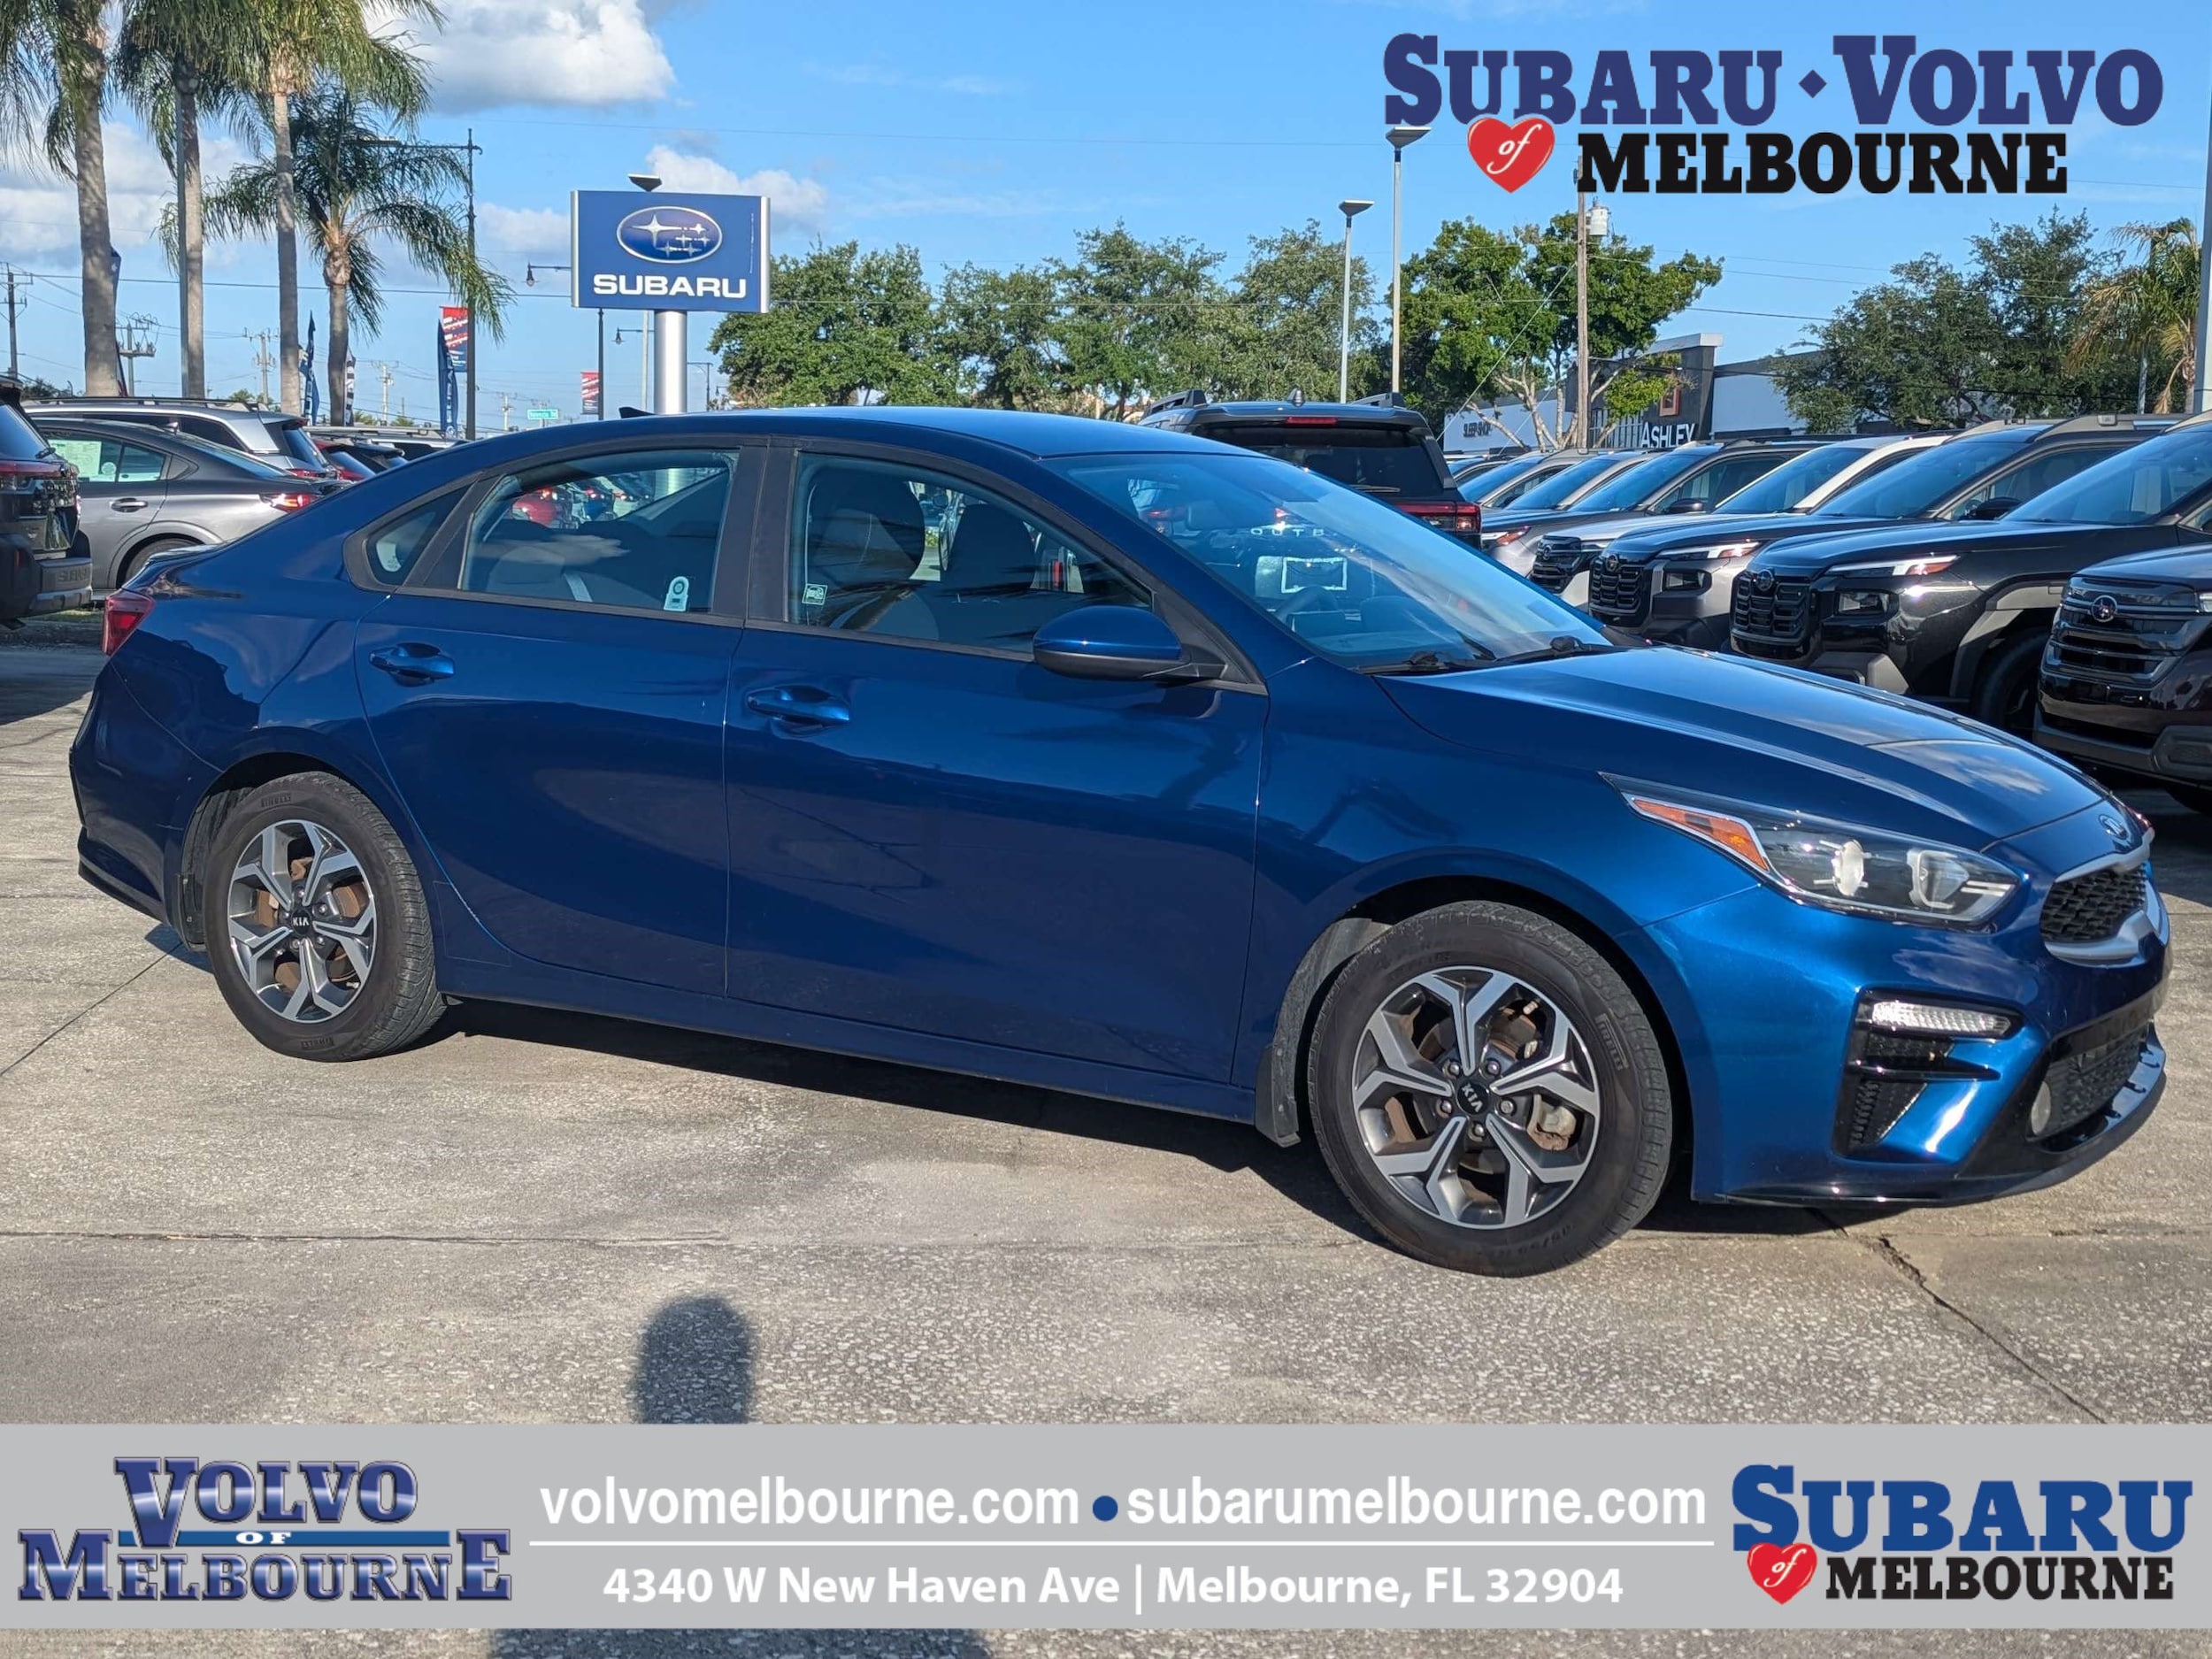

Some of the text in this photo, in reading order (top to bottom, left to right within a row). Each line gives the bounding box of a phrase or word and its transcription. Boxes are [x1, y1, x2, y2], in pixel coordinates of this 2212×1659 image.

[593, 273, 747, 299] SUBARU
[1640, 421, 1695, 449] ASHLEY
[293, 917, 310, 926] KIA
[1462, 1083, 1483, 1112] KIA
